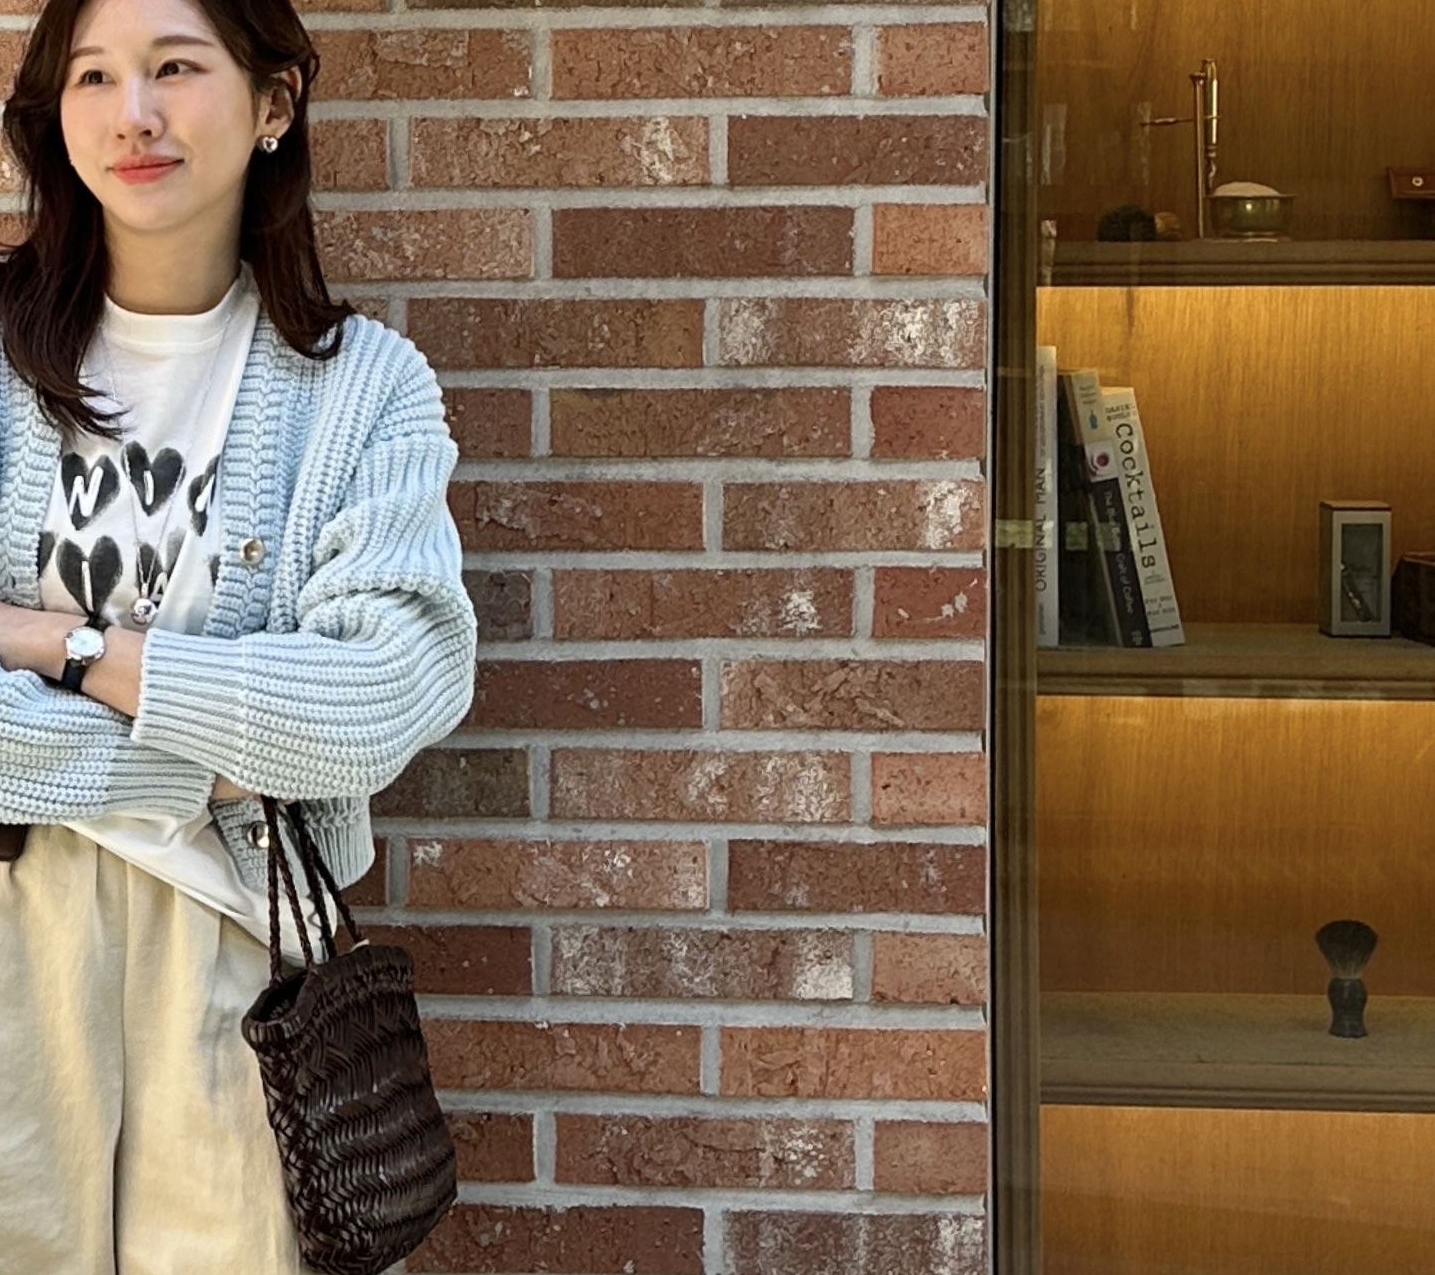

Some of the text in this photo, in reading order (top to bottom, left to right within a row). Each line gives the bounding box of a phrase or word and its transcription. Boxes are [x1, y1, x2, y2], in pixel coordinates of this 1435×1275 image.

[1036, 468, 1046, 504] MAN
[1116, 422, 1158, 568] Cocktails
[1035, 514, 1047, 592] ORIGINAL
